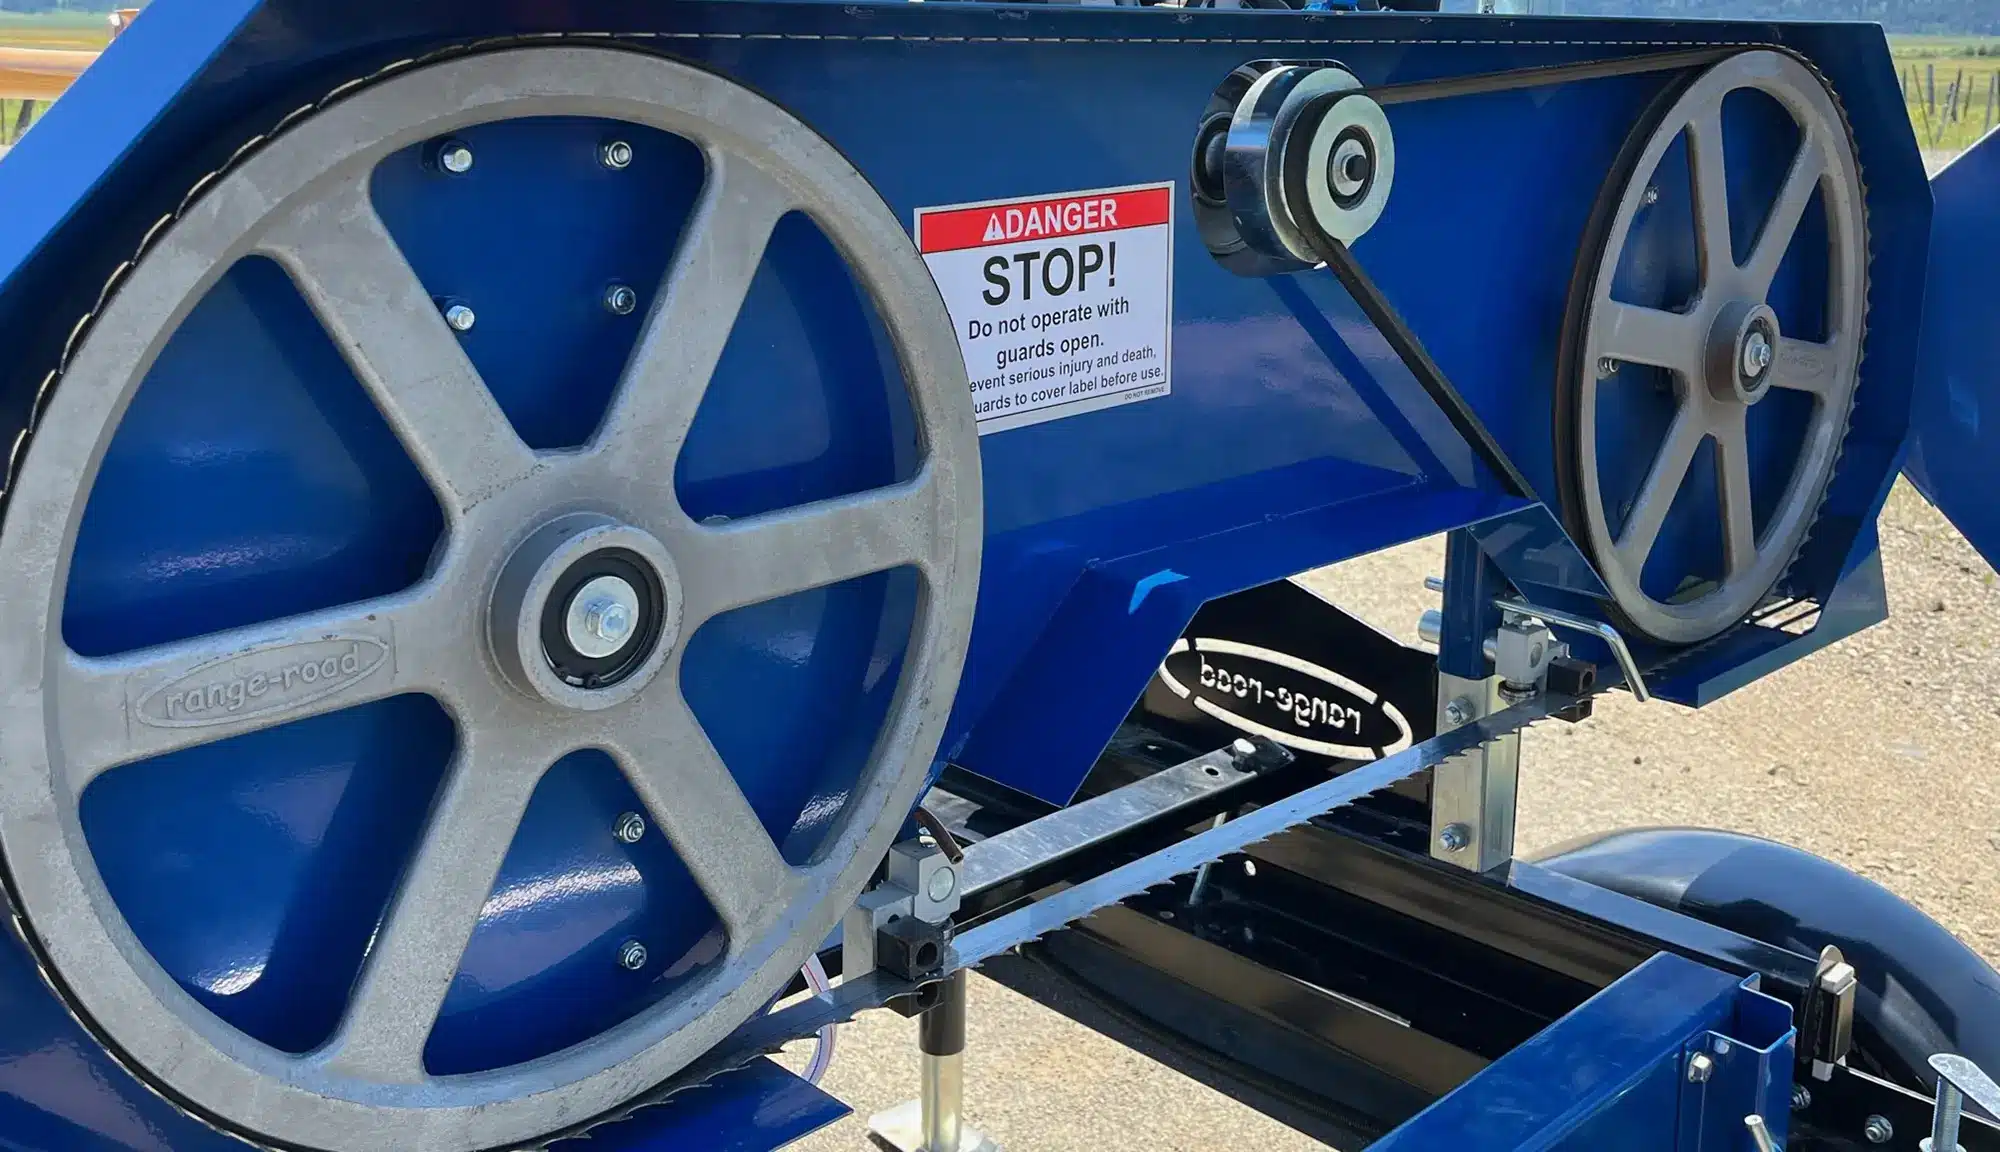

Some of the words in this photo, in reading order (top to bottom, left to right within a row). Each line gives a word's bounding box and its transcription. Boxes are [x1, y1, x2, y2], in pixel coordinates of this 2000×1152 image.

[1006, 199, 1118, 238] DANGER
[982, 241, 1116, 306] STOP!
[968, 320, 992, 340] Do
[998, 313, 1026, 335] not
[1031, 303, 1093, 331] operate
[1097, 296, 1130, 318] with
[969, 373, 1006, 392] event
[1009, 366, 1056, 385] serious
[1059, 359, 1093, 377] injury
[1096, 351, 1118, 368] and
[1121, 344, 1157, 363] death,
[996, 339, 1055, 370] guards
[1060, 332, 1104, 356] open.
[975, 395, 1011, 414] uards
[1015, 393, 1027, 406] to
[1031, 386, 1066, 402] cover
[1069, 376, 1097, 395] label
[1101, 371, 1138, 388] before
[1140, 366, 1164, 380] use.
[1133, 390, 1144, 398] NOT
[164, 642, 361, 721] range-road
